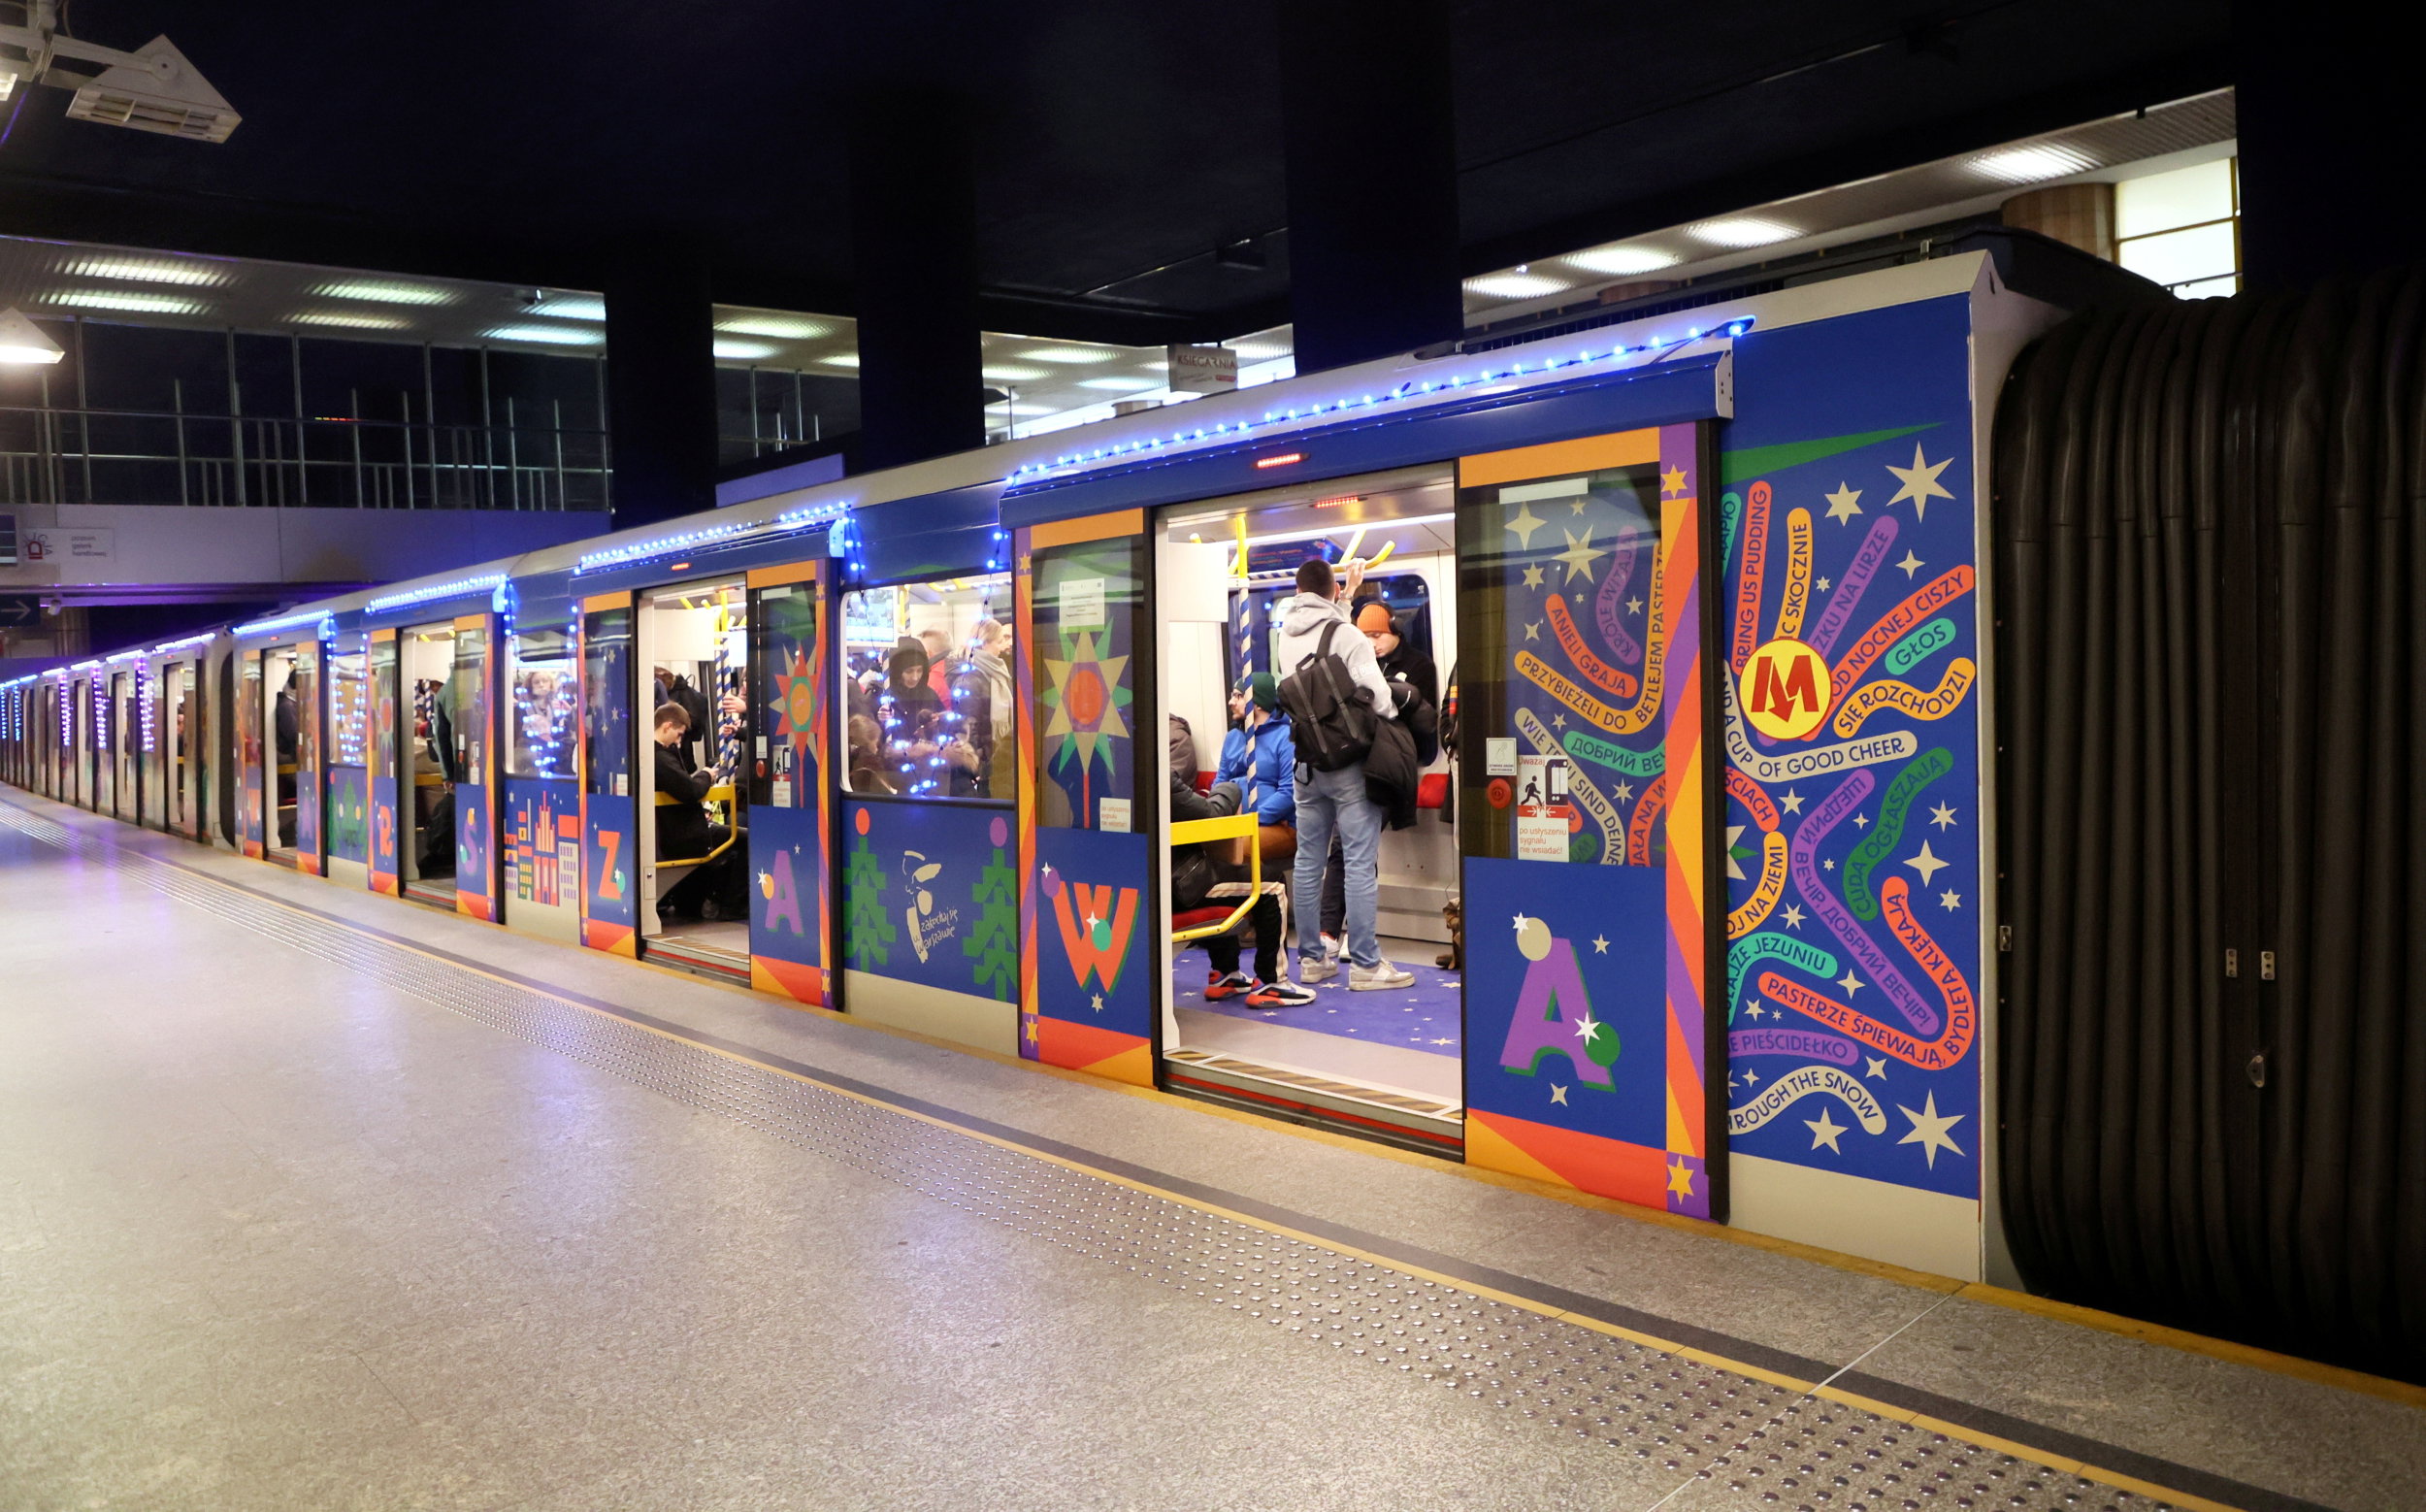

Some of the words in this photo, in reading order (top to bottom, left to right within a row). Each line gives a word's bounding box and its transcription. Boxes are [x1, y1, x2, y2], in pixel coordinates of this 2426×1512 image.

[1746, 490, 1767, 575] PUDDING
[1743, 581, 1757, 604] US
[1787, 523, 1808, 618] SKOCZNIE
[1814, 611, 1842, 654] ZKU
[1835, 583, 1860, 611] NA
[1852, 530, 1888, 579] LIRZE
[1551, 608, 1582, 655] ANIELI
[1580, 654, 1625, 696] GRAJĄ
[1736, 608, 1755, 669] BRING
[1831, 670, 1852, 703] OD
[1848, 607, 1914, 671] NOCNEJ
[1916, 572, 1963, 611] CISZY
[1895, 625, 1947, 666] GŁOS
[1522, 657, 1600, 719] PRZYBIEŻELI
[1603, 712, 1627, 730] DO
[1635, 641, 1663, 723] BETLEJEM
[1839, 705, 1864, 732] SIĘ
[1858, 670, 1967, 715] ROZCHODZI
[1724, 714, 1737, 727] A
[1727, 731, 1754, 763] CUP
[1571, 738, 1636, 771] ДОБРИЙ
[1759, 762, 1782, 777] OF
[1787, 750, 1844, 773] GOOD
[1849, 738, 1905, 762] CHEER
[1523, 715, 1546, 745] WIE
[1575, 779, 1606, 815] SIND
[1603, 816, 1623, 865] DEINE
[1637, 800, 1656, 824] NA
[1800, 777, 1866, 845] ЩЕДРИЙ
[1745, 898, 1770, 923] NA
[1762, 846, 1784, 896] ZIEMI
[1849, 861, 1872, 914] CUDA
[598, 830, 622, 902] Z
[765, 850, 804, 937] A
[1052, 881, 1140, 996] W
[1500, 937, 1615, 1091] A
[1754, 937, 1827, 971] JEZUNIU
[1820, 906, 1886, 975] ДОБРИЙ
[1767, 978, 1849, 1027] PASTERZE
[1883, 972, 1931, 1028] ВЕЧІР!
[1742, 1032, 1848, 1059] PIEŚCIDEŁKO
[1788, 1070, 1820, 1093] THE
[1824, 1072, 1878, 1119] SNOW
